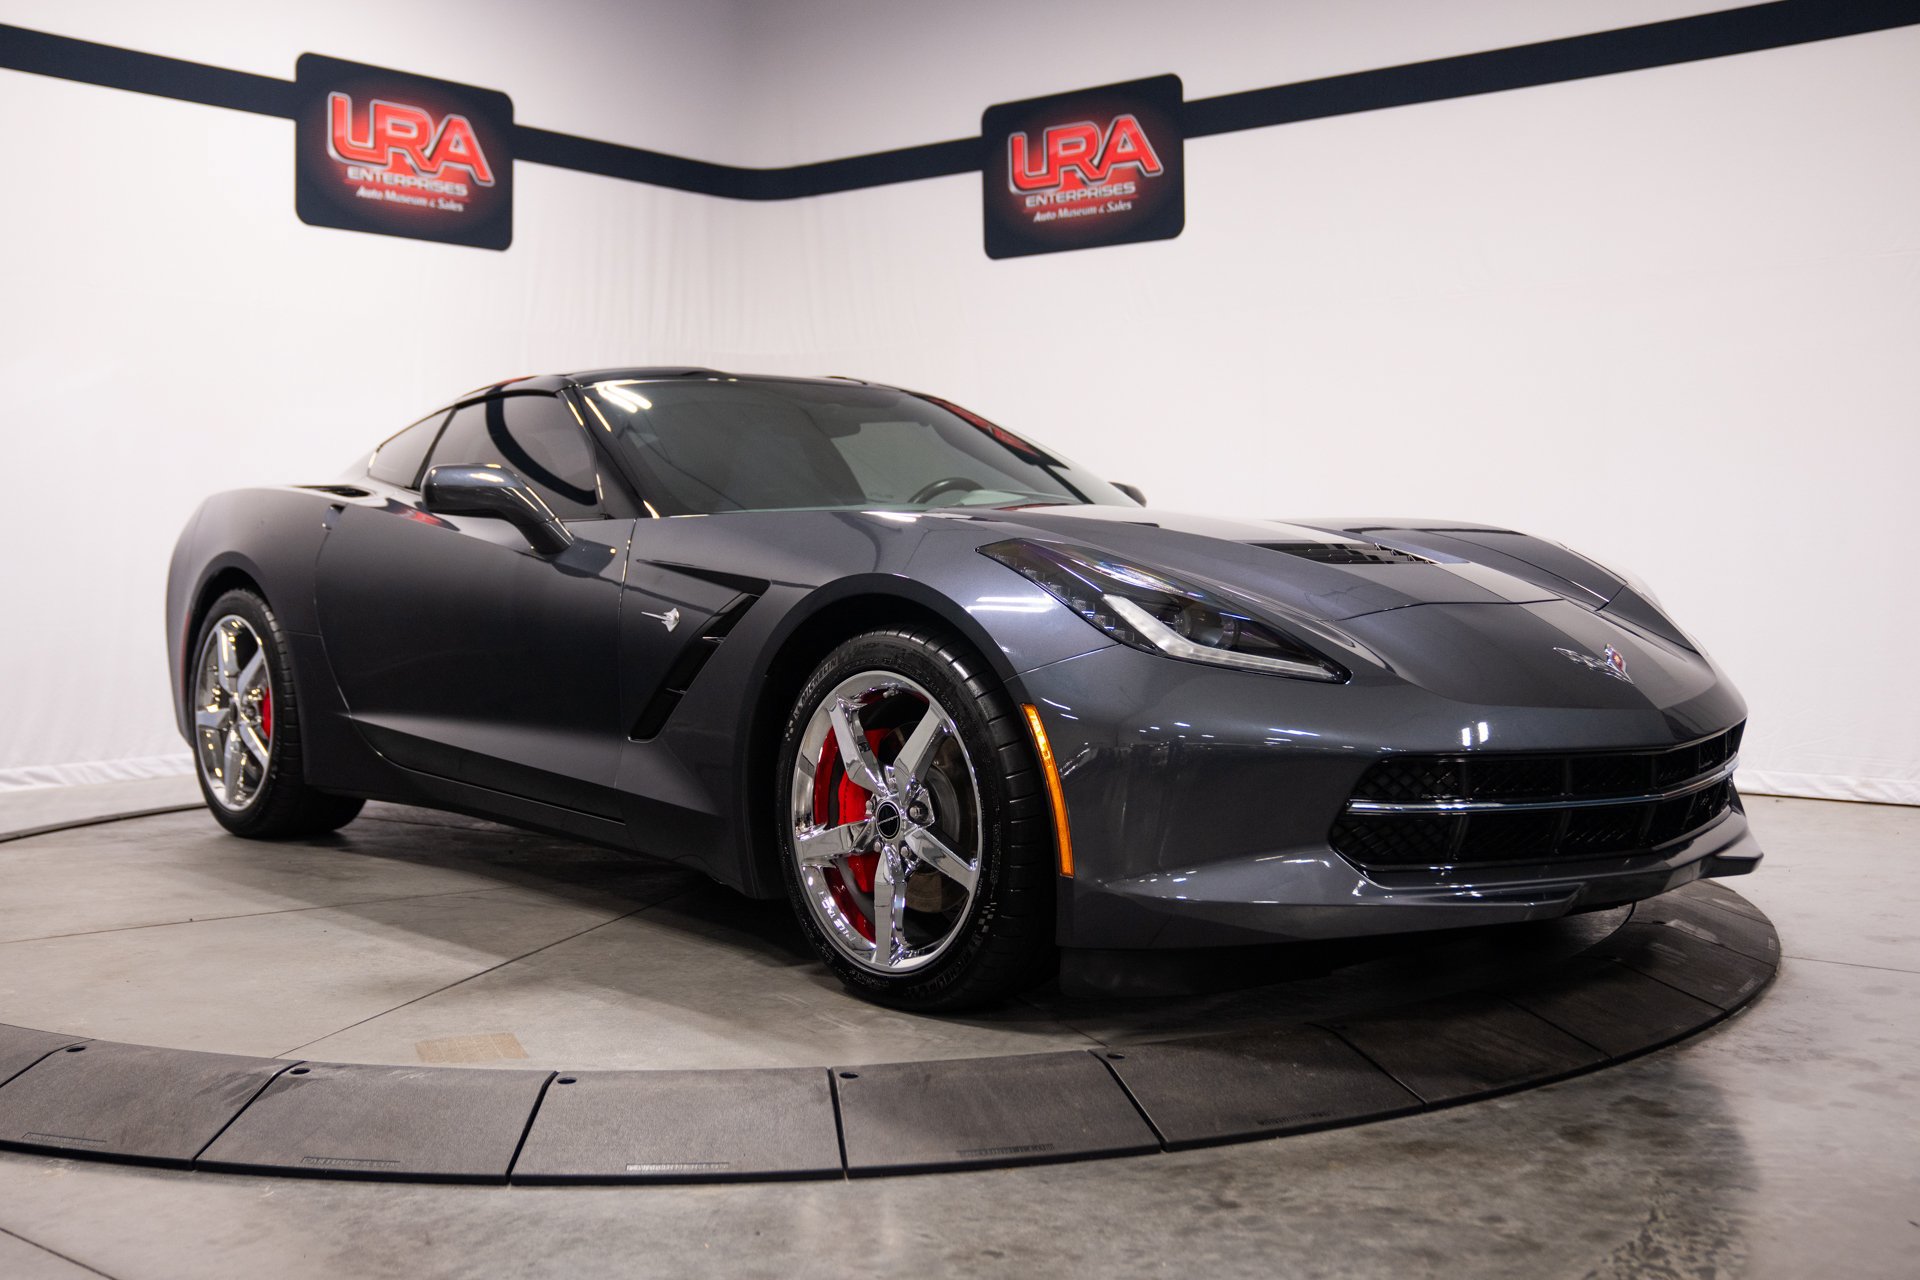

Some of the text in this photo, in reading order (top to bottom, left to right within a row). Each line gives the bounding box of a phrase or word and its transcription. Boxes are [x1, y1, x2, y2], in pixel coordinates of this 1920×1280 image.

[328, 91, 495, 187] URA
[1009, 114, 1163, 195] URA
[348, 167, 467, 195] ENTERPRISES
[357, 187, 383, 200] Auto
[384, 190, 427, 207] Museum
[437, 196, 464, 212] Sales
[1025, 182, 1135, 207] ENTERPRISES
[1034, 210, 1056, 222] Auto
[1057, 205, 1097, 220] Museum
[1106, 199, 1132, 213] Sales
